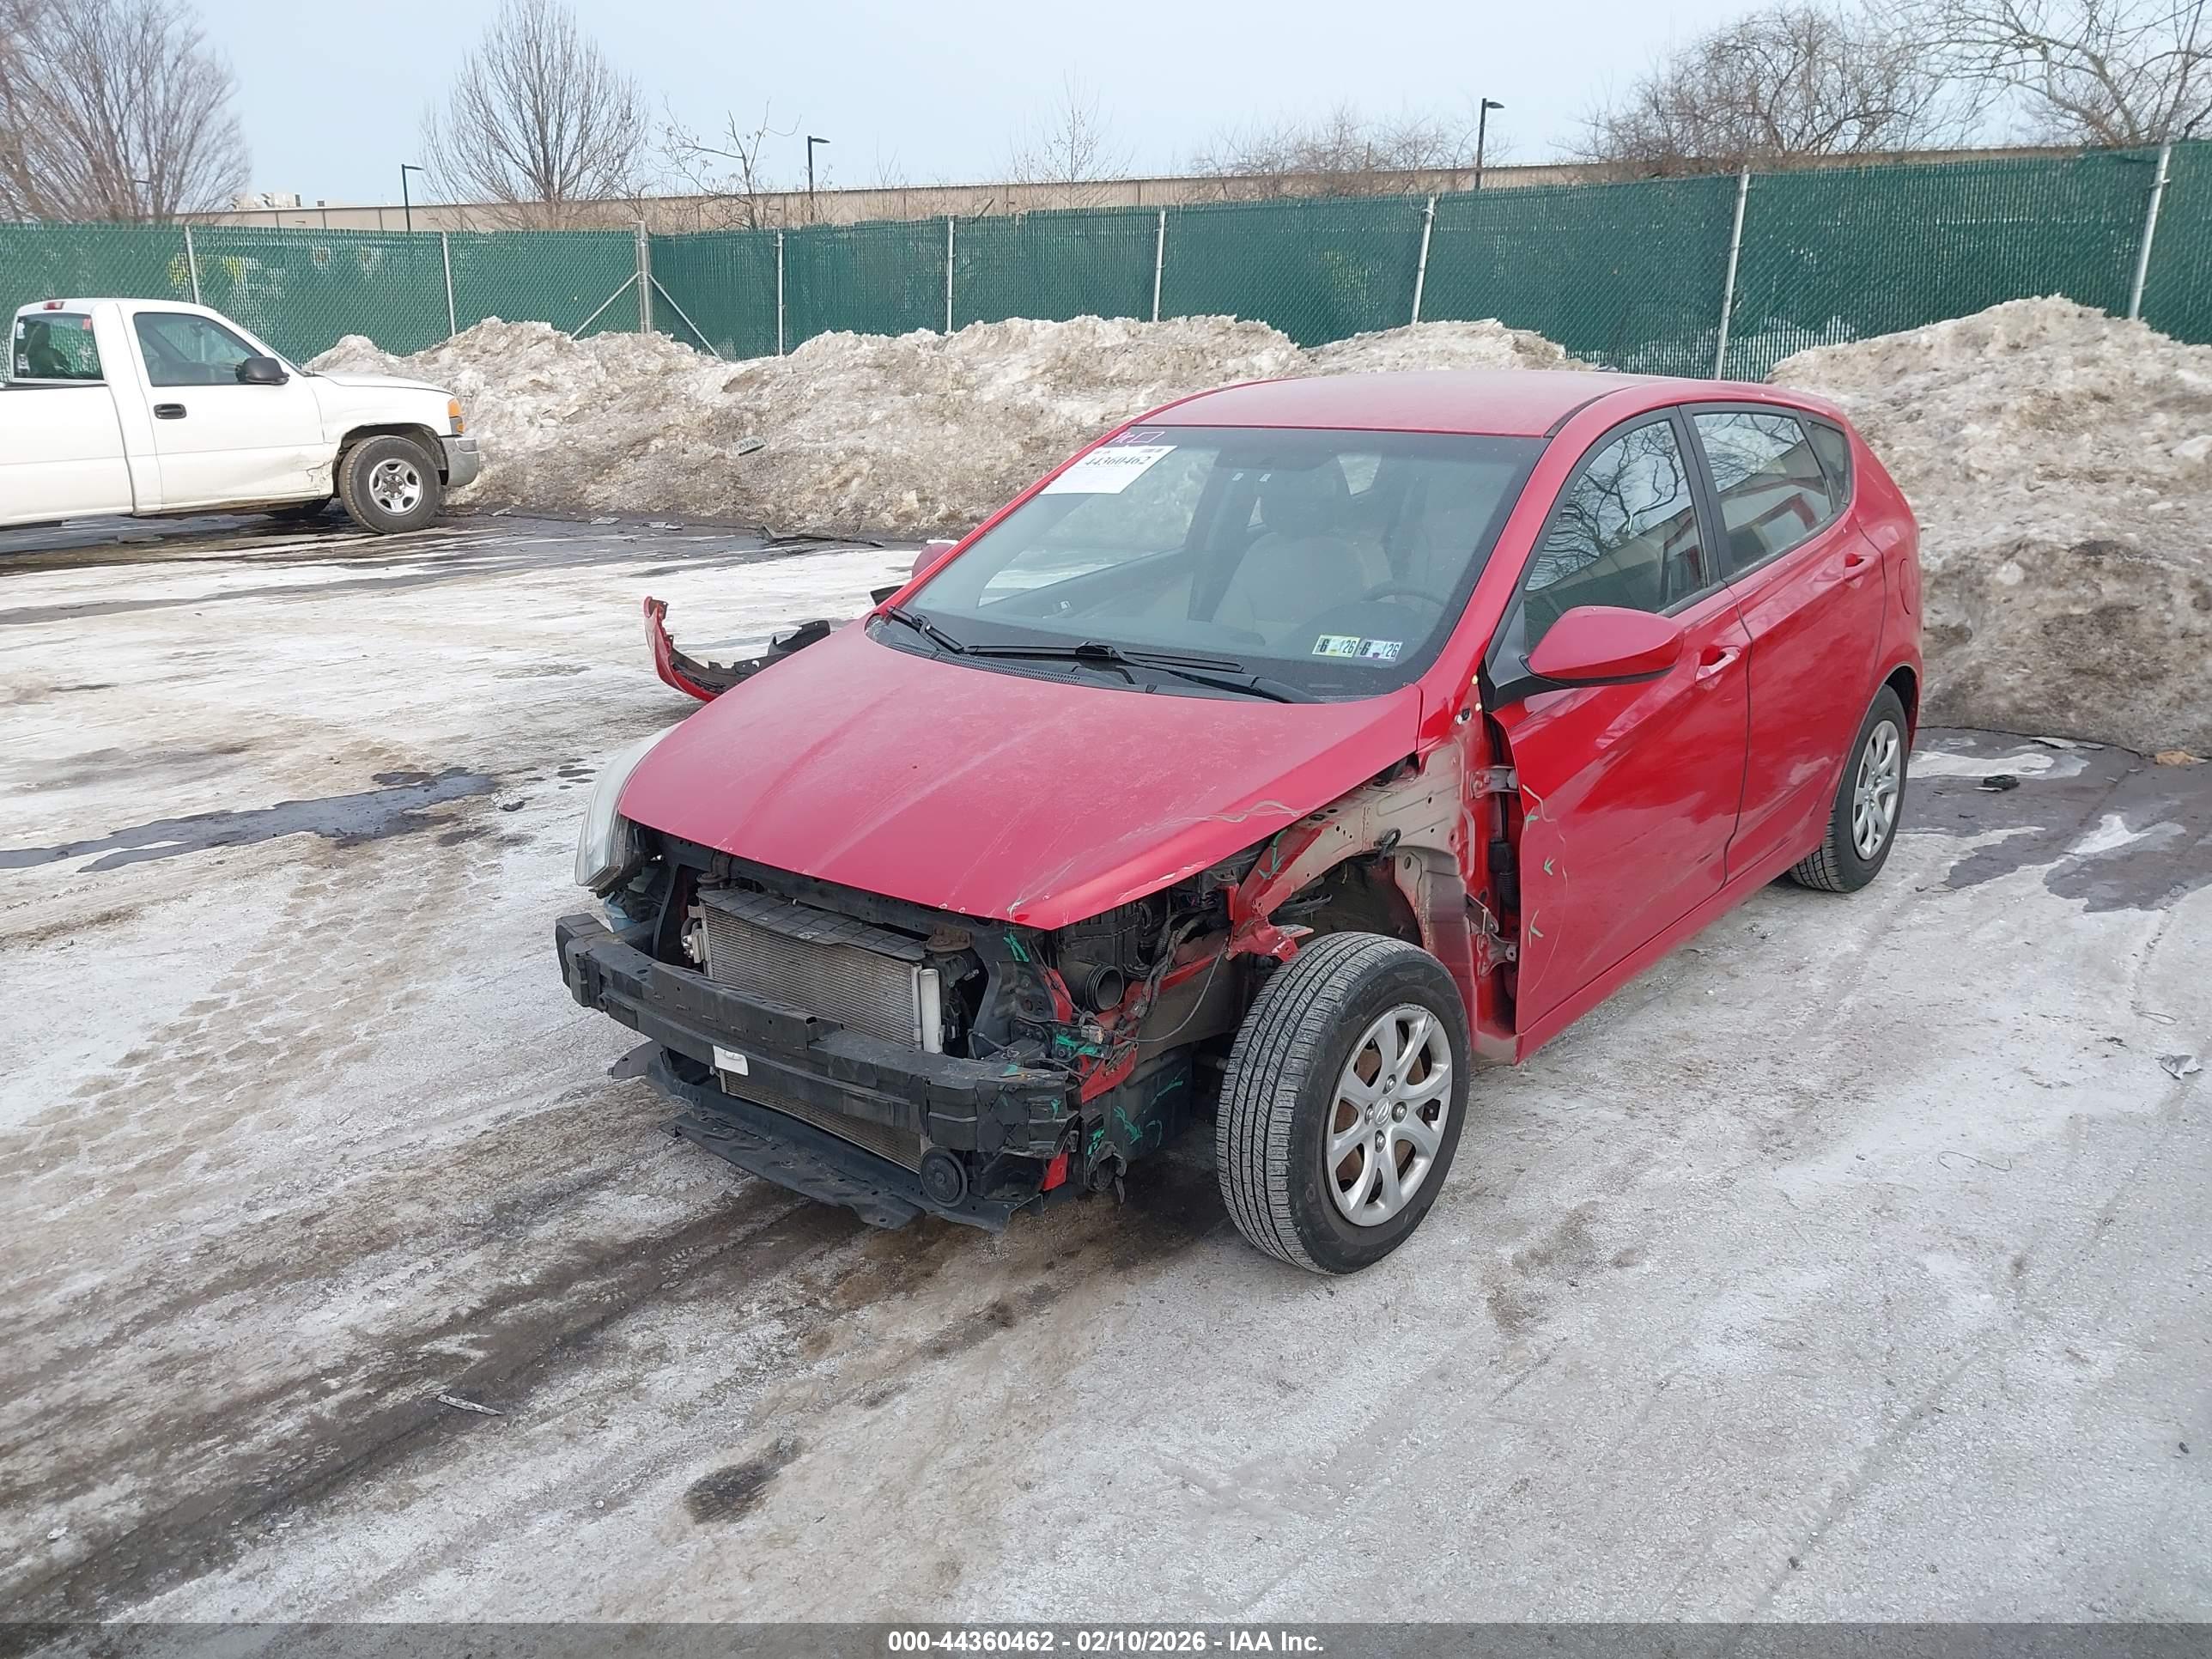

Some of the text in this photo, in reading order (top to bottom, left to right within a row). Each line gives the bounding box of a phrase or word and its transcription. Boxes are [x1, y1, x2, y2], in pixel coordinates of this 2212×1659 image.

[1085, 455, 1152, 466] 44360462
[1319, 638, 1357, 654] 6 26
[1360, 641, 1400, 658] 6 26
